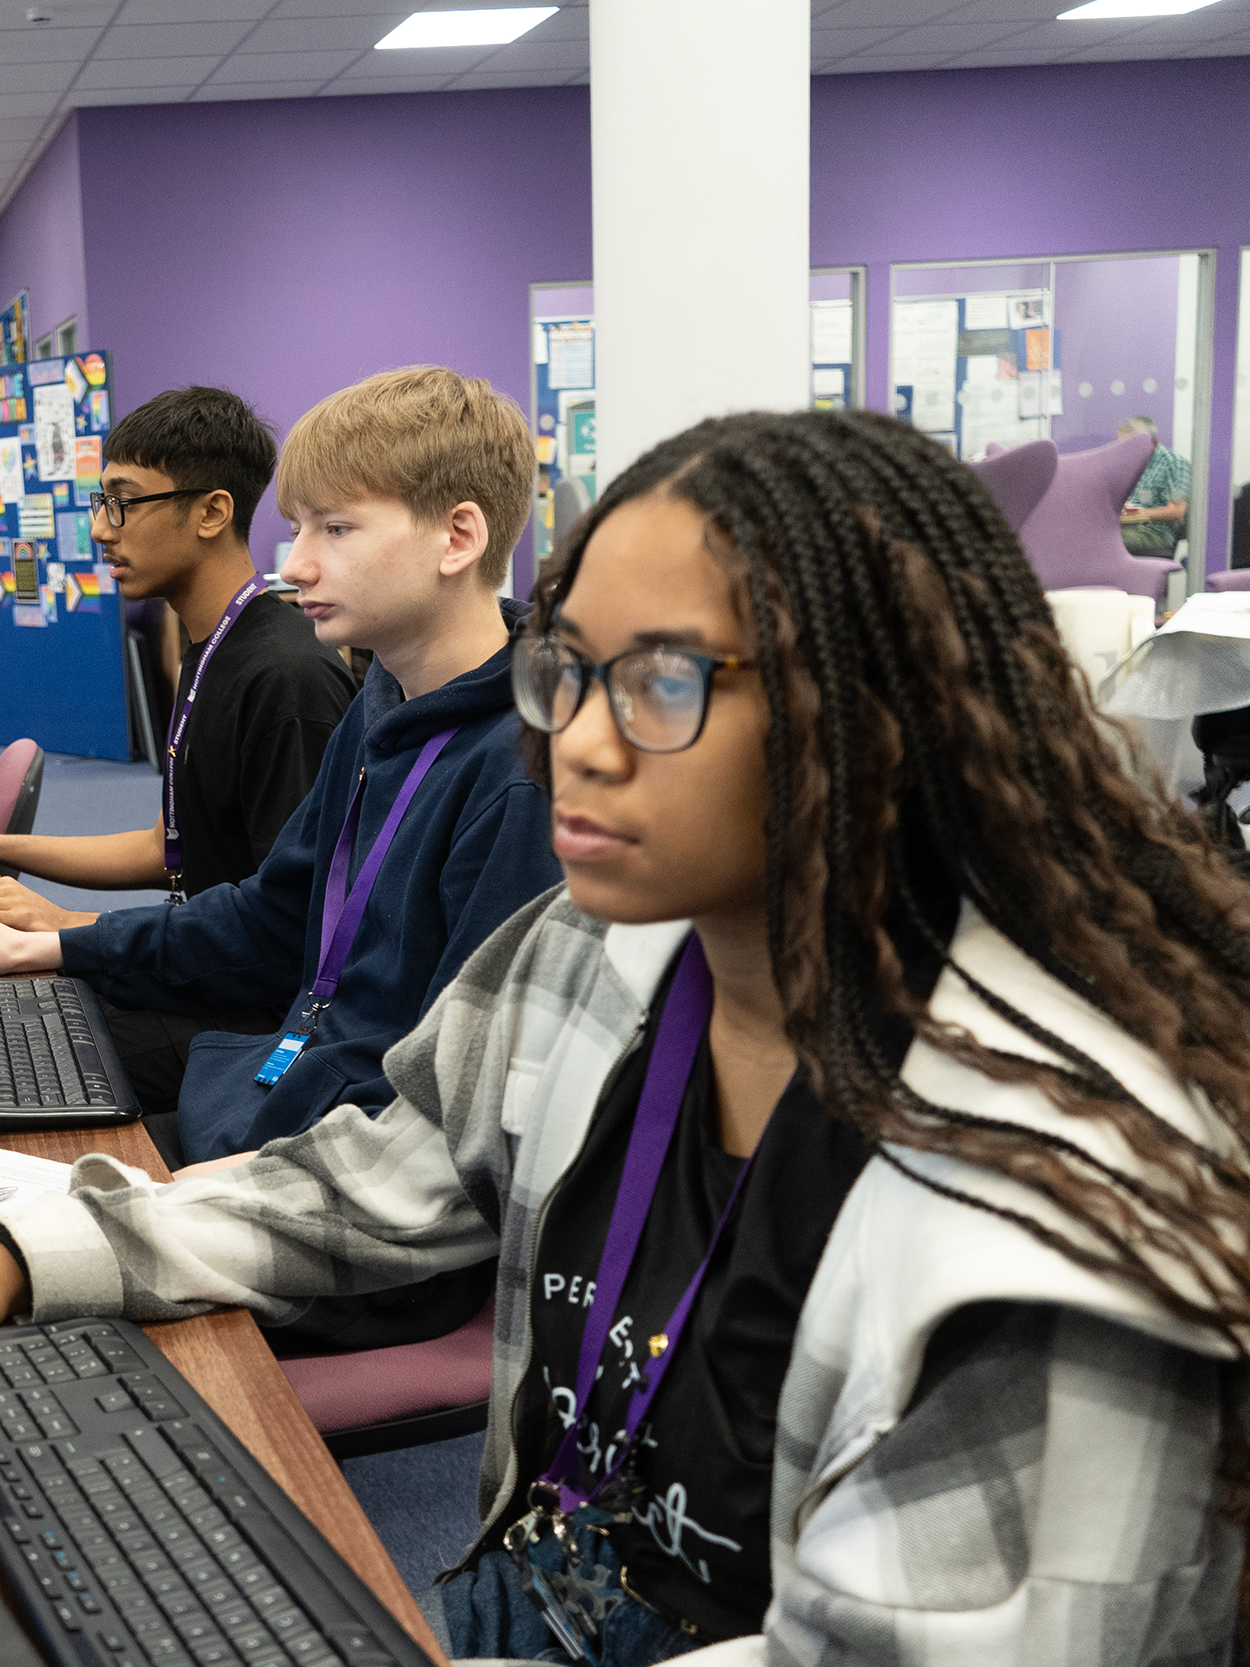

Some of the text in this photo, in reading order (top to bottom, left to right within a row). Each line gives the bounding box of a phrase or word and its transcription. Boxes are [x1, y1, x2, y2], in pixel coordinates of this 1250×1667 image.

[192, 583, 257, 690] NOTTINGHAM COLLEGE STUDENT
[173, 714, 188, 746] STUDENT
